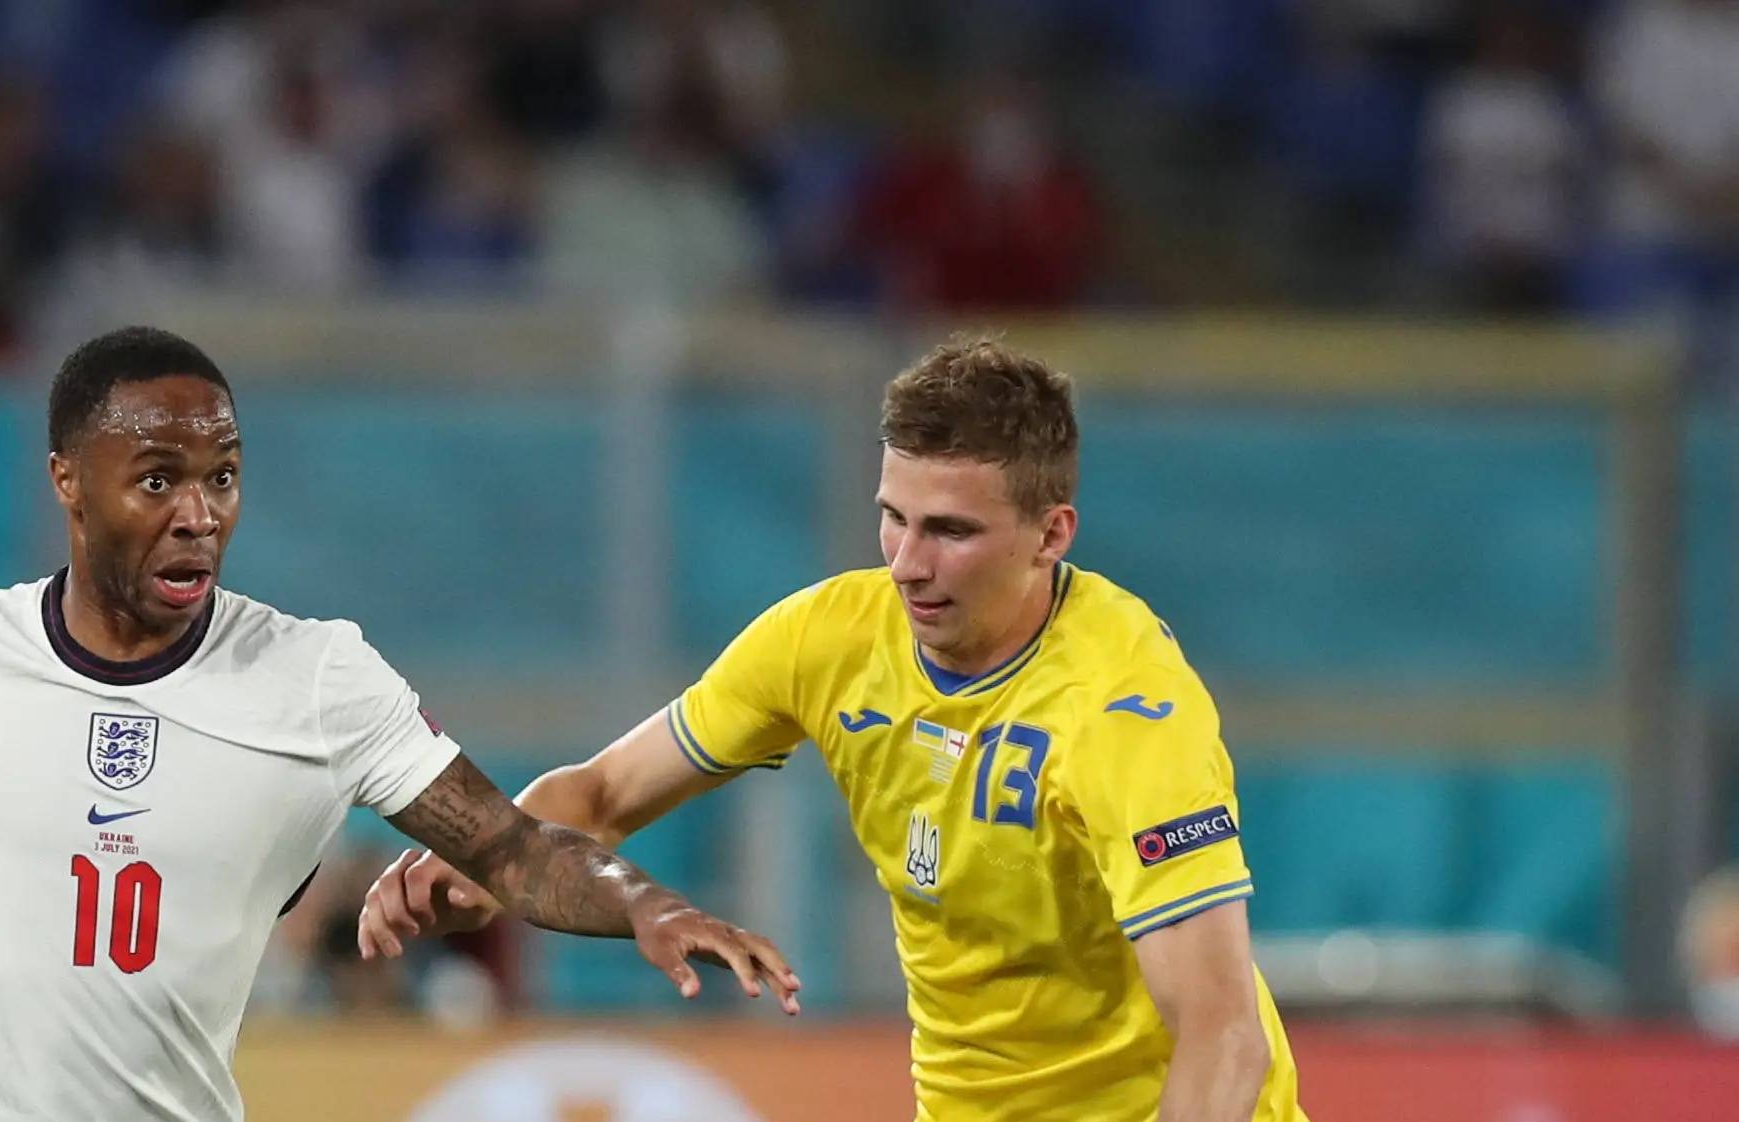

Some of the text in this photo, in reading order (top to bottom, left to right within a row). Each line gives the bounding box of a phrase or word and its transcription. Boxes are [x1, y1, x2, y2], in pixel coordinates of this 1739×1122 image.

[971, 721, 1051, 828] 13
[99, 831, 134, 844] UKRAINE
[1165, 814, 1232, 847] RESPECT
[101, 843, 120, 853] JULY
[122, 845, 139, 856] 2021
[70, 854, 163, 974] 10
